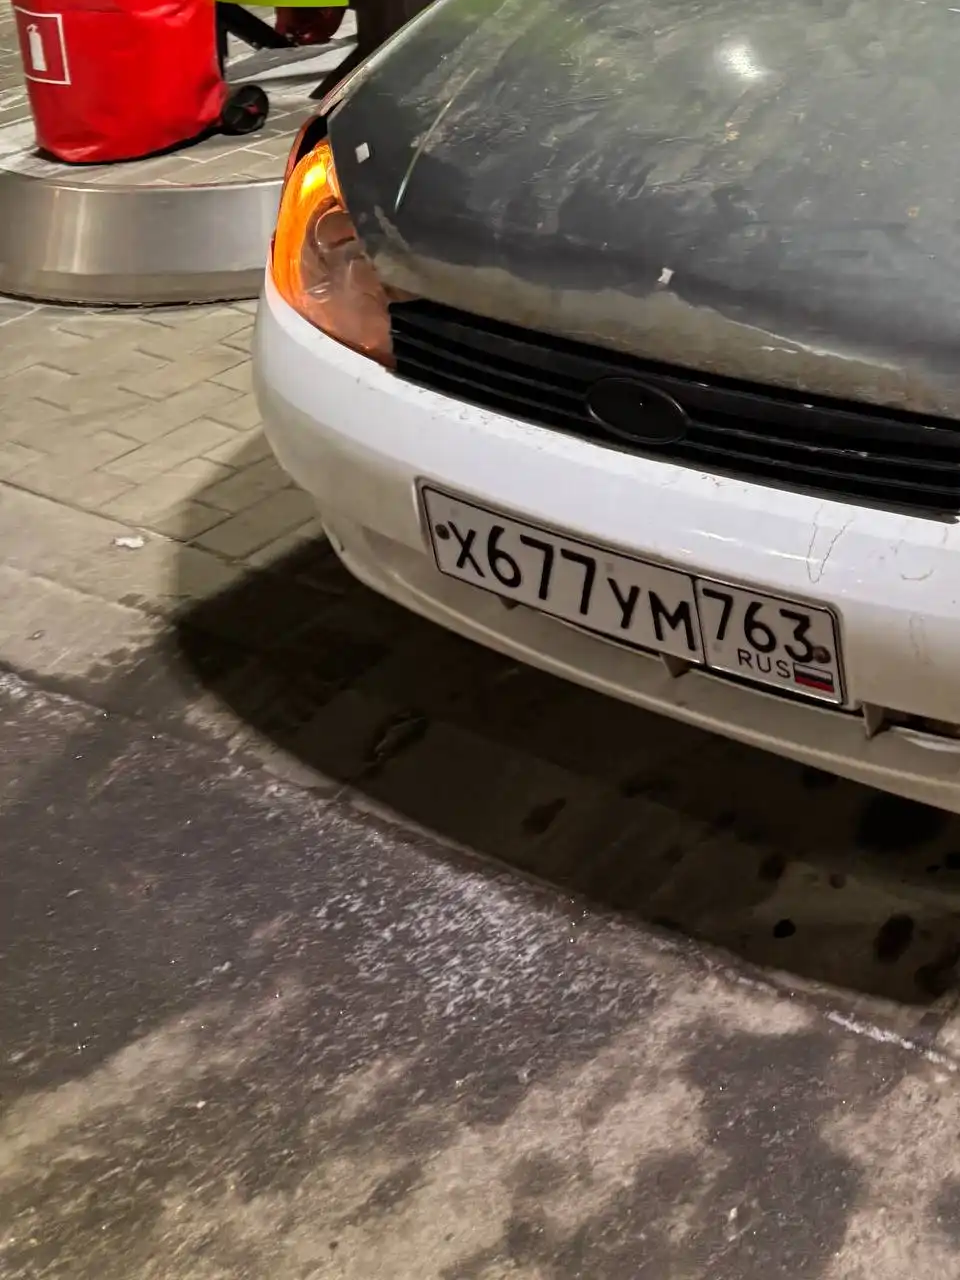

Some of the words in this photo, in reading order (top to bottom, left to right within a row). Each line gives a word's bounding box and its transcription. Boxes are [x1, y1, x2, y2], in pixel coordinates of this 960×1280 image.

[448, 519, 697, 652] Х677УМ
[703, 588, 815, 664] 763
[737, 648, 791, 678] RUS
